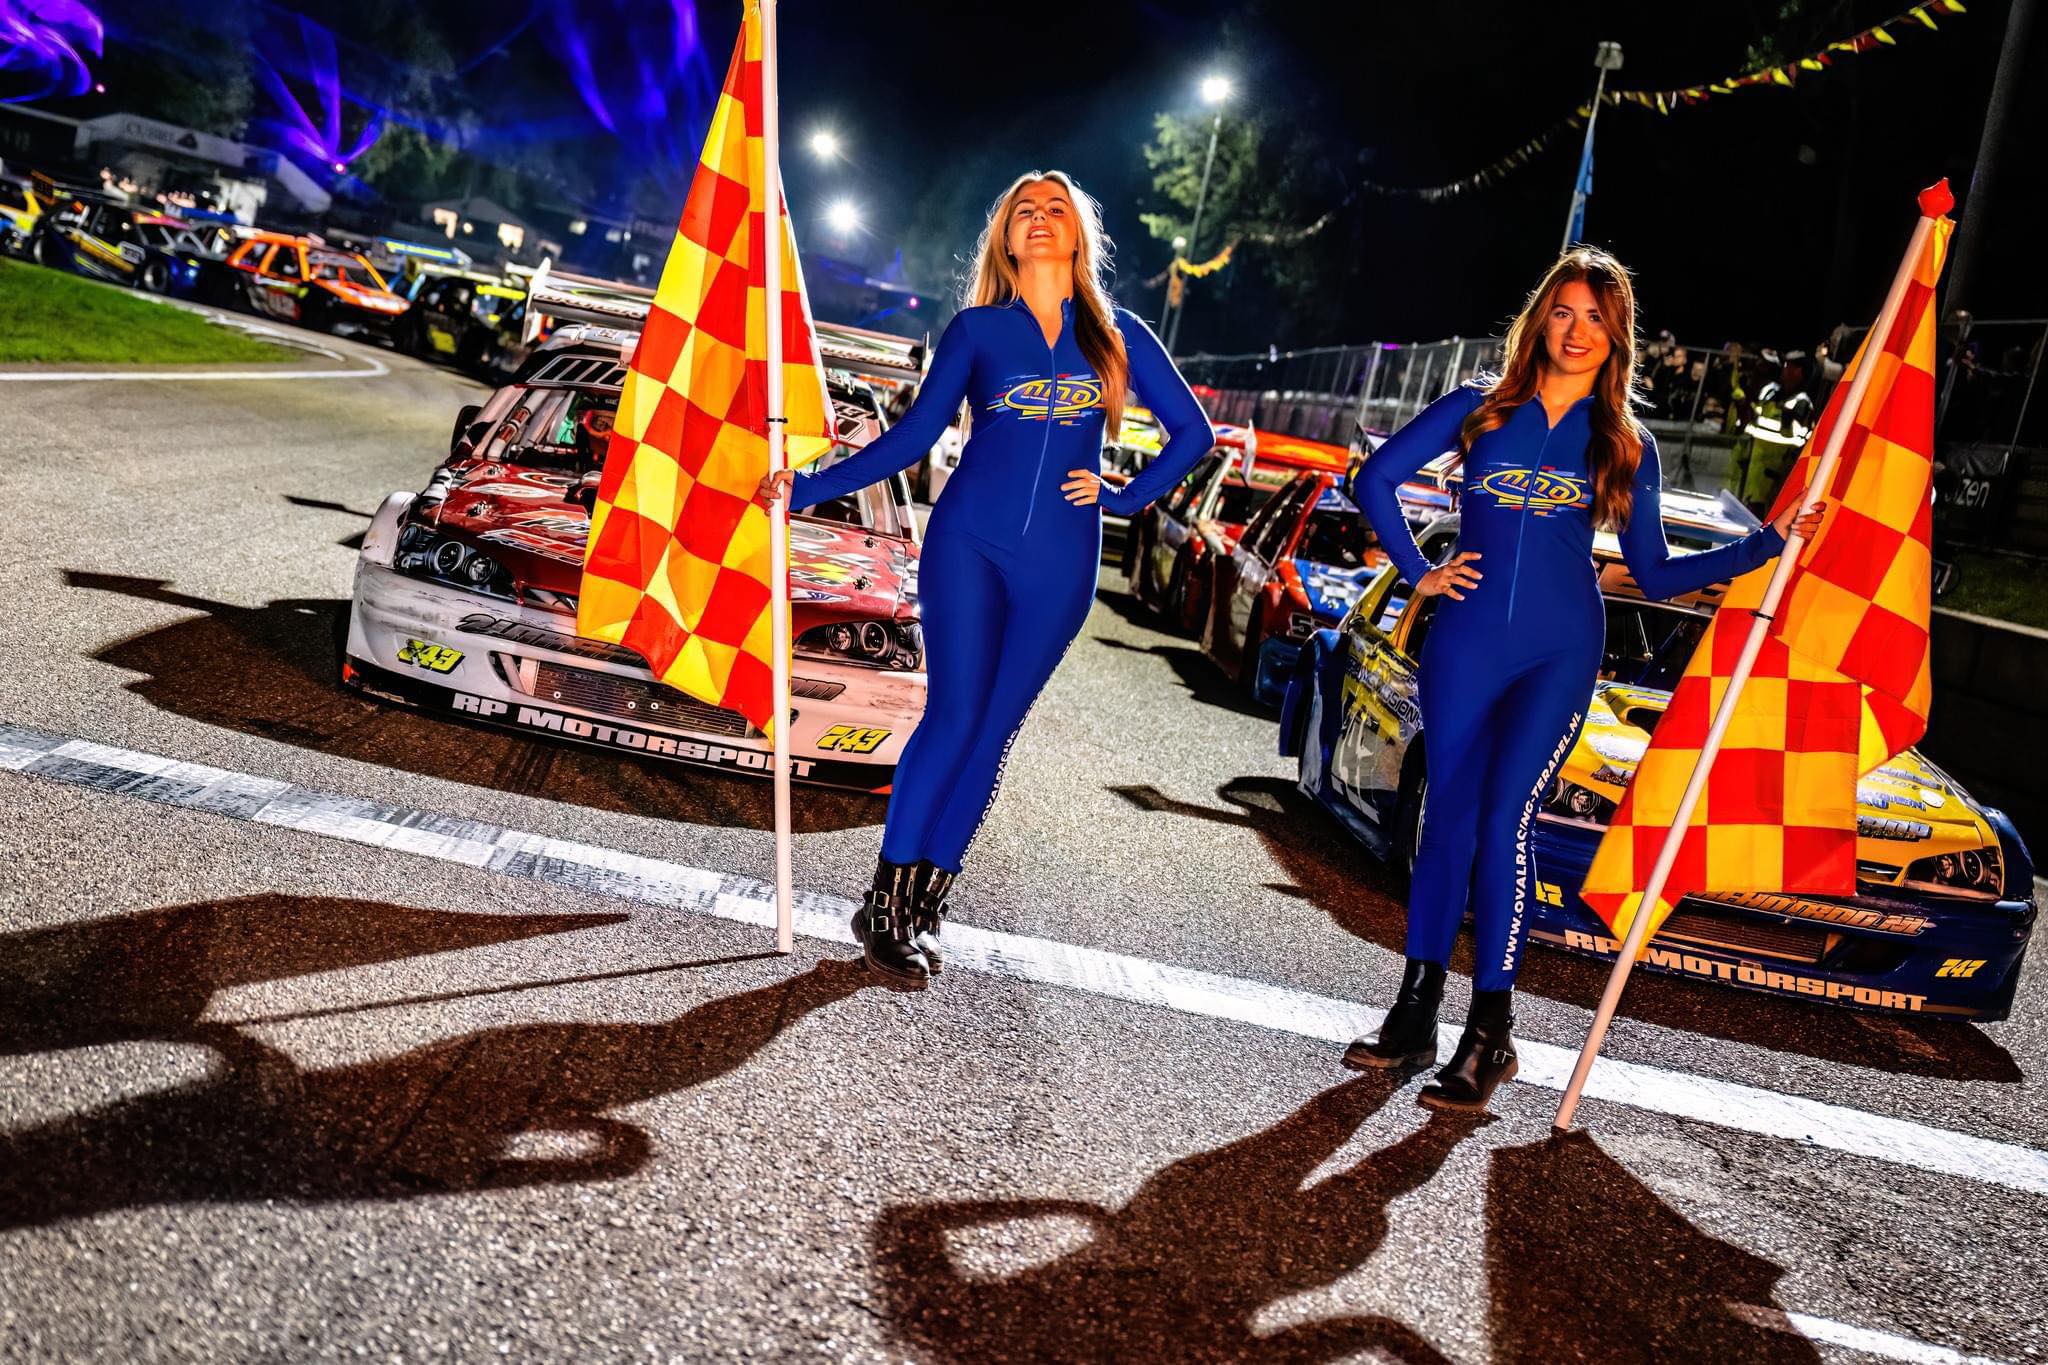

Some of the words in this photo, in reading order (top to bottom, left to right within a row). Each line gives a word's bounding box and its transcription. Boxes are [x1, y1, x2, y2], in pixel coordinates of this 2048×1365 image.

[452, 692, 508, 717] RP
[815, 724, 893, 754] 743
[1502, 711, 1582, 971] WWW.OVALRACING-TERAPEL.NL
[1564, 929, 1622, 954] RP
[1644, 946, 1928, 1011] MOTORSPORT
[1934, 958, 1989, 979] 747
